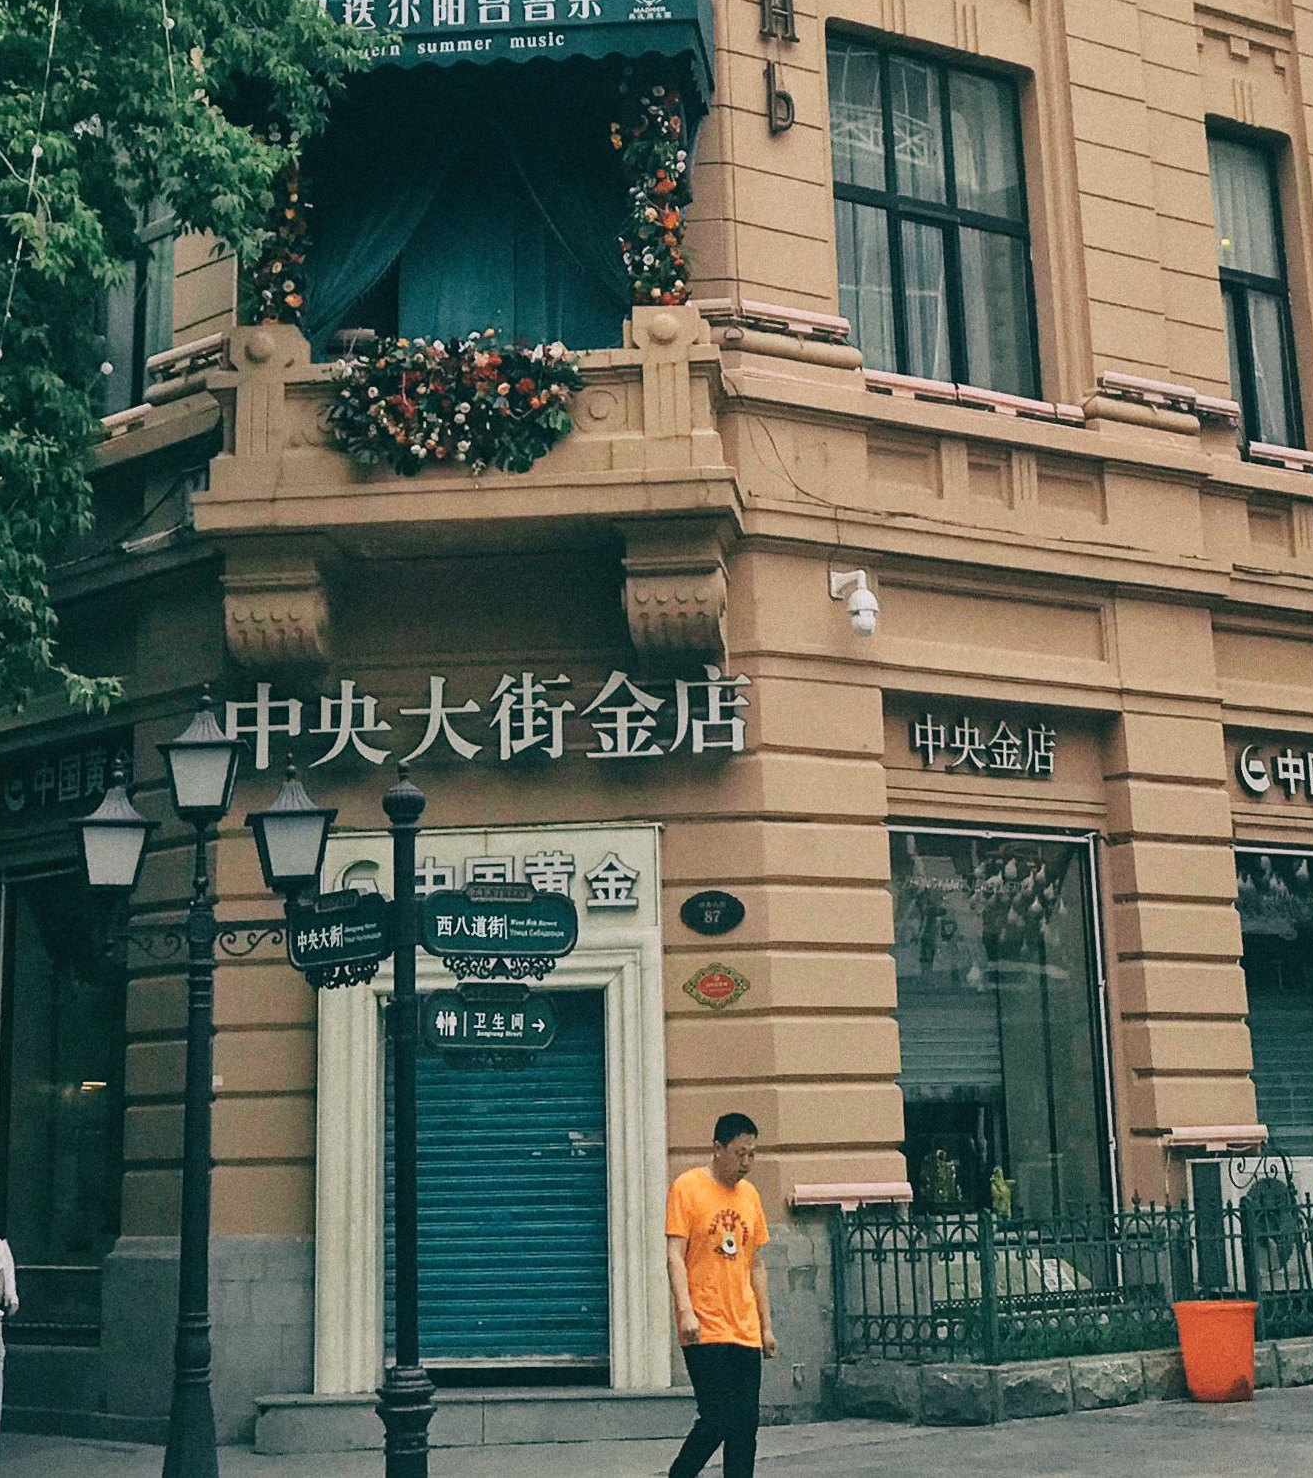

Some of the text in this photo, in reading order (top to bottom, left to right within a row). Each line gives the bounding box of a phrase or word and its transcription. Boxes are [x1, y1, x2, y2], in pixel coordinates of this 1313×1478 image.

[417, 38, 492, 54] summer
[510, 32, 565, 49] music
[225, 665, 752, 770] 中央大街金店
[915, 713, 1057, 773] 中央金店
[297, 924, 341, 953] 中央大街
[436, 915, 504, 938] 西八道街
[473, 1012, 525, 1030] 卫生间
